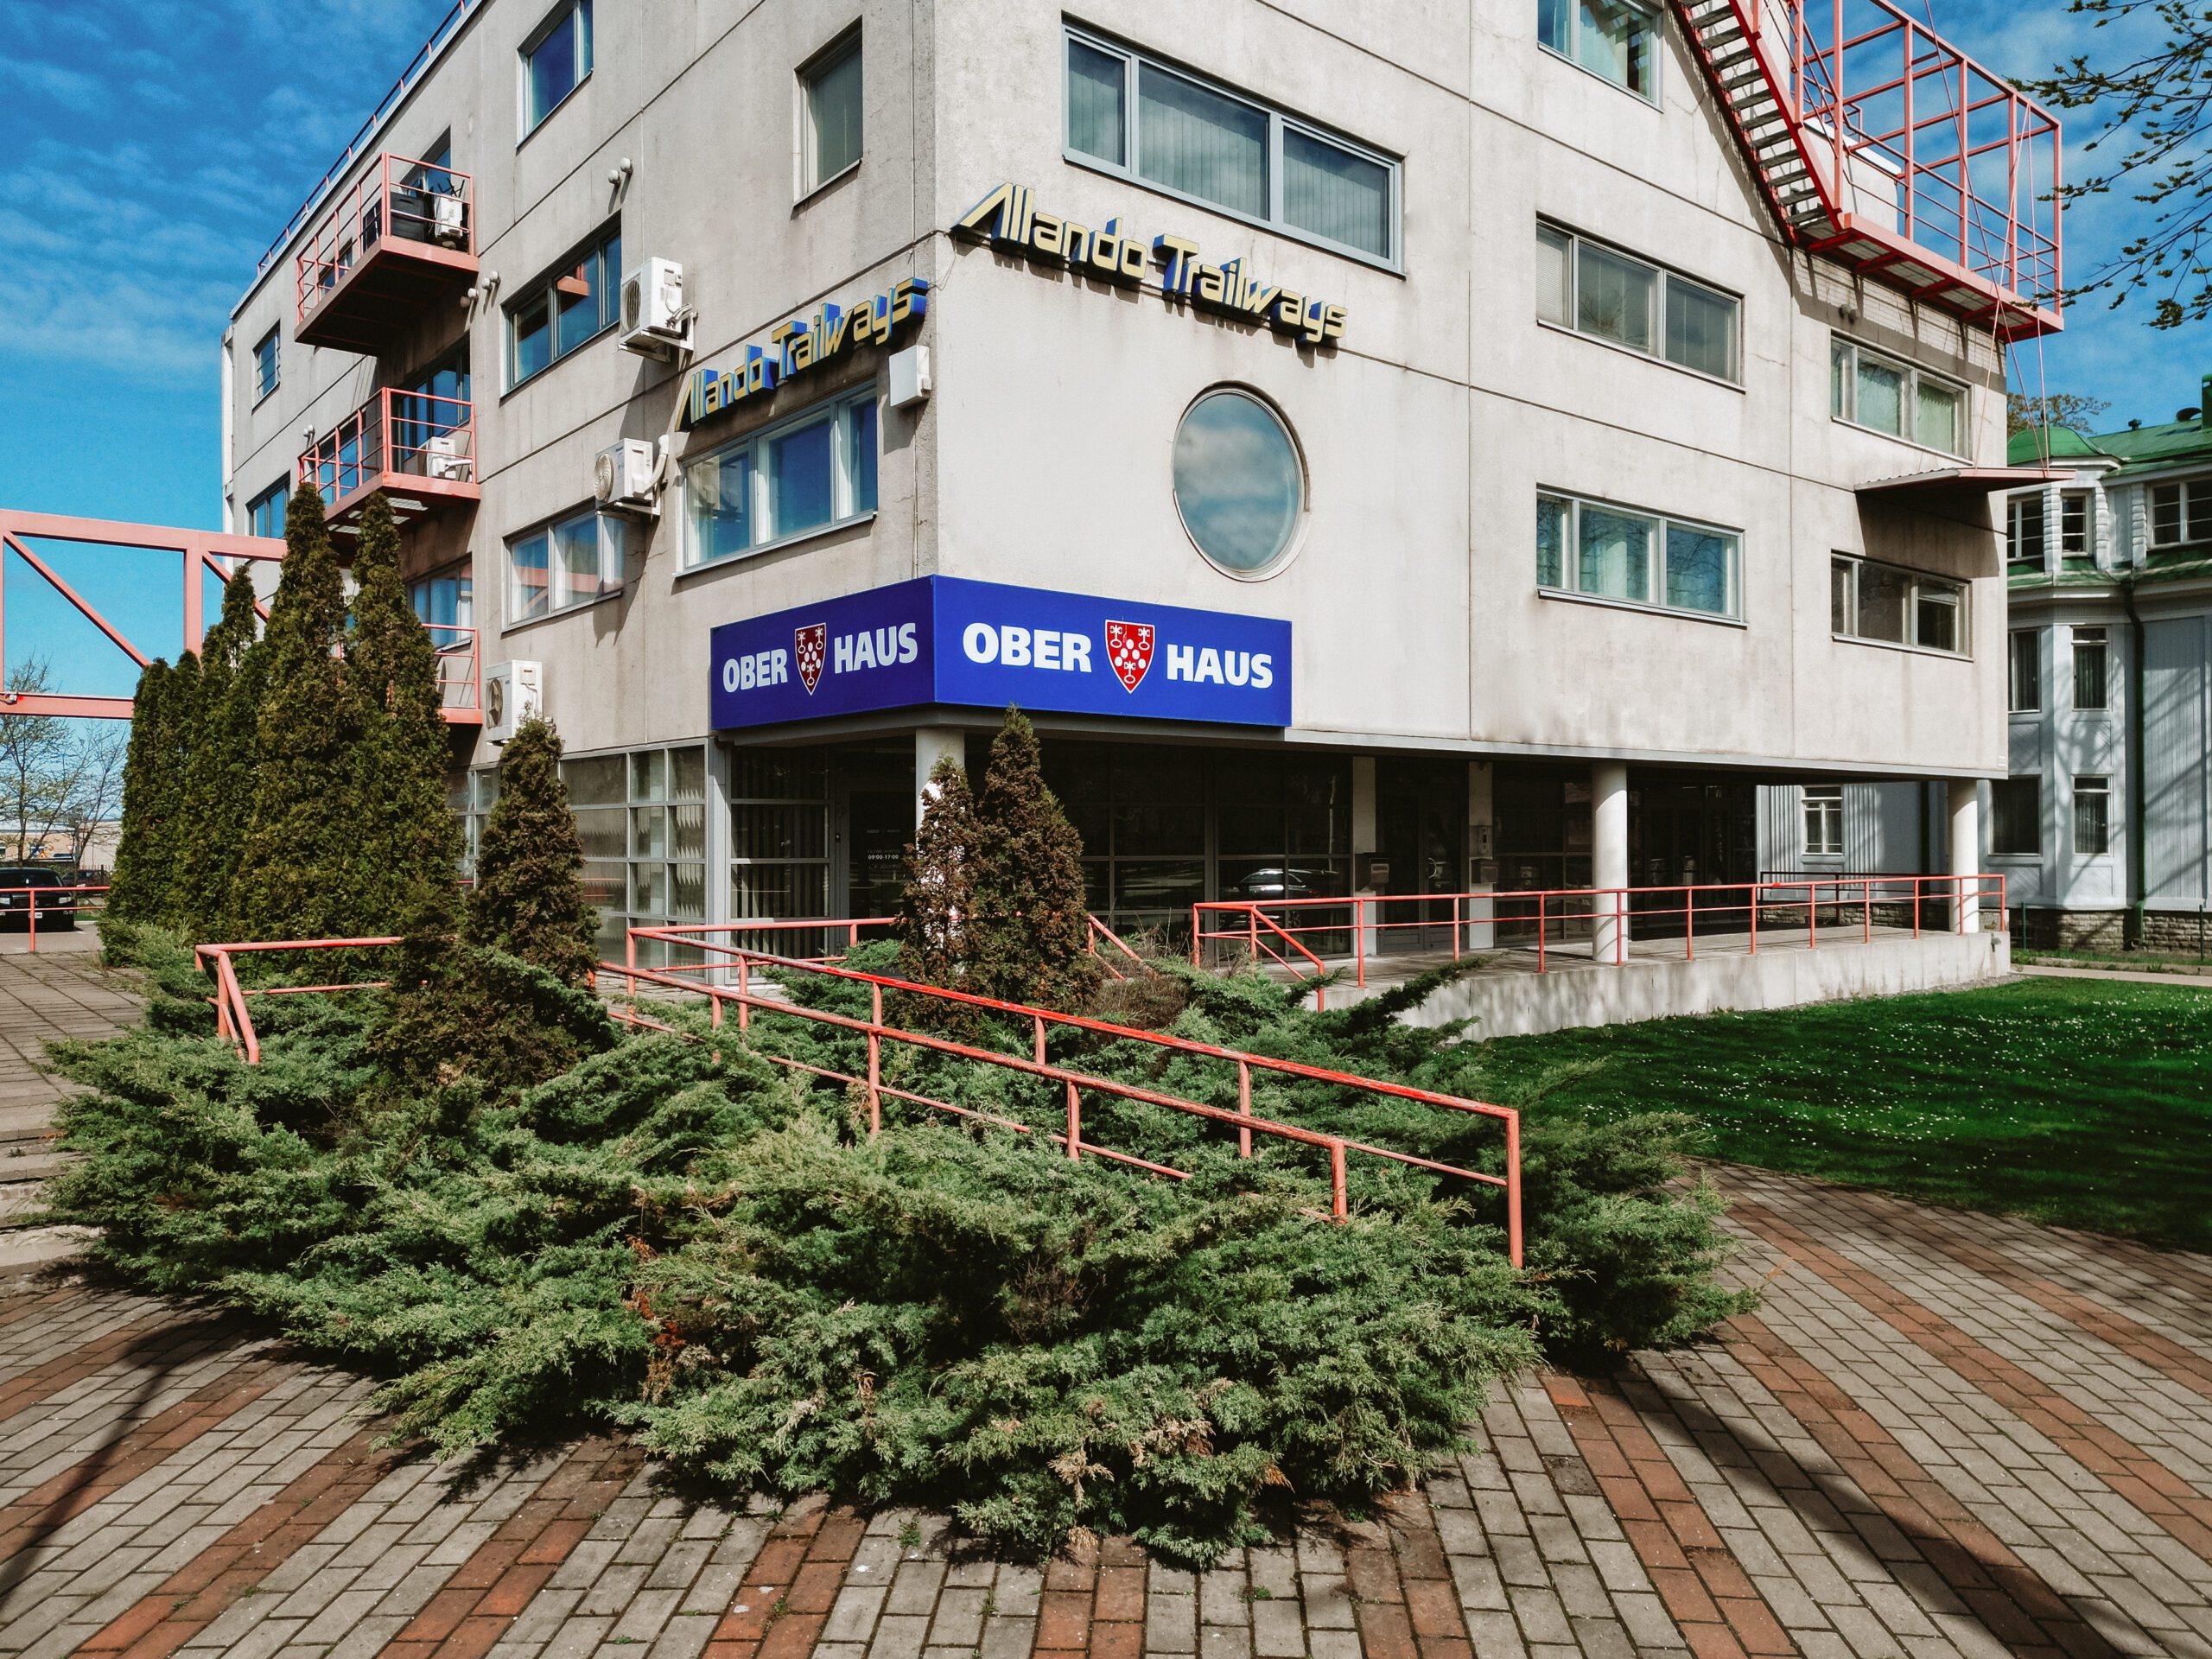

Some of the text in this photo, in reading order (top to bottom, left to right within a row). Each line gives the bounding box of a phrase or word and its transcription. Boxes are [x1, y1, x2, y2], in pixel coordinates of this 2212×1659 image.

[952, 182, 1348, 343] Allando Trailways
[675, 277, 927, 432] Allando Trailways
[723, 623, 918, 692] OBER HAUS
[963, 623, 1273, 689] OBER HAUS
